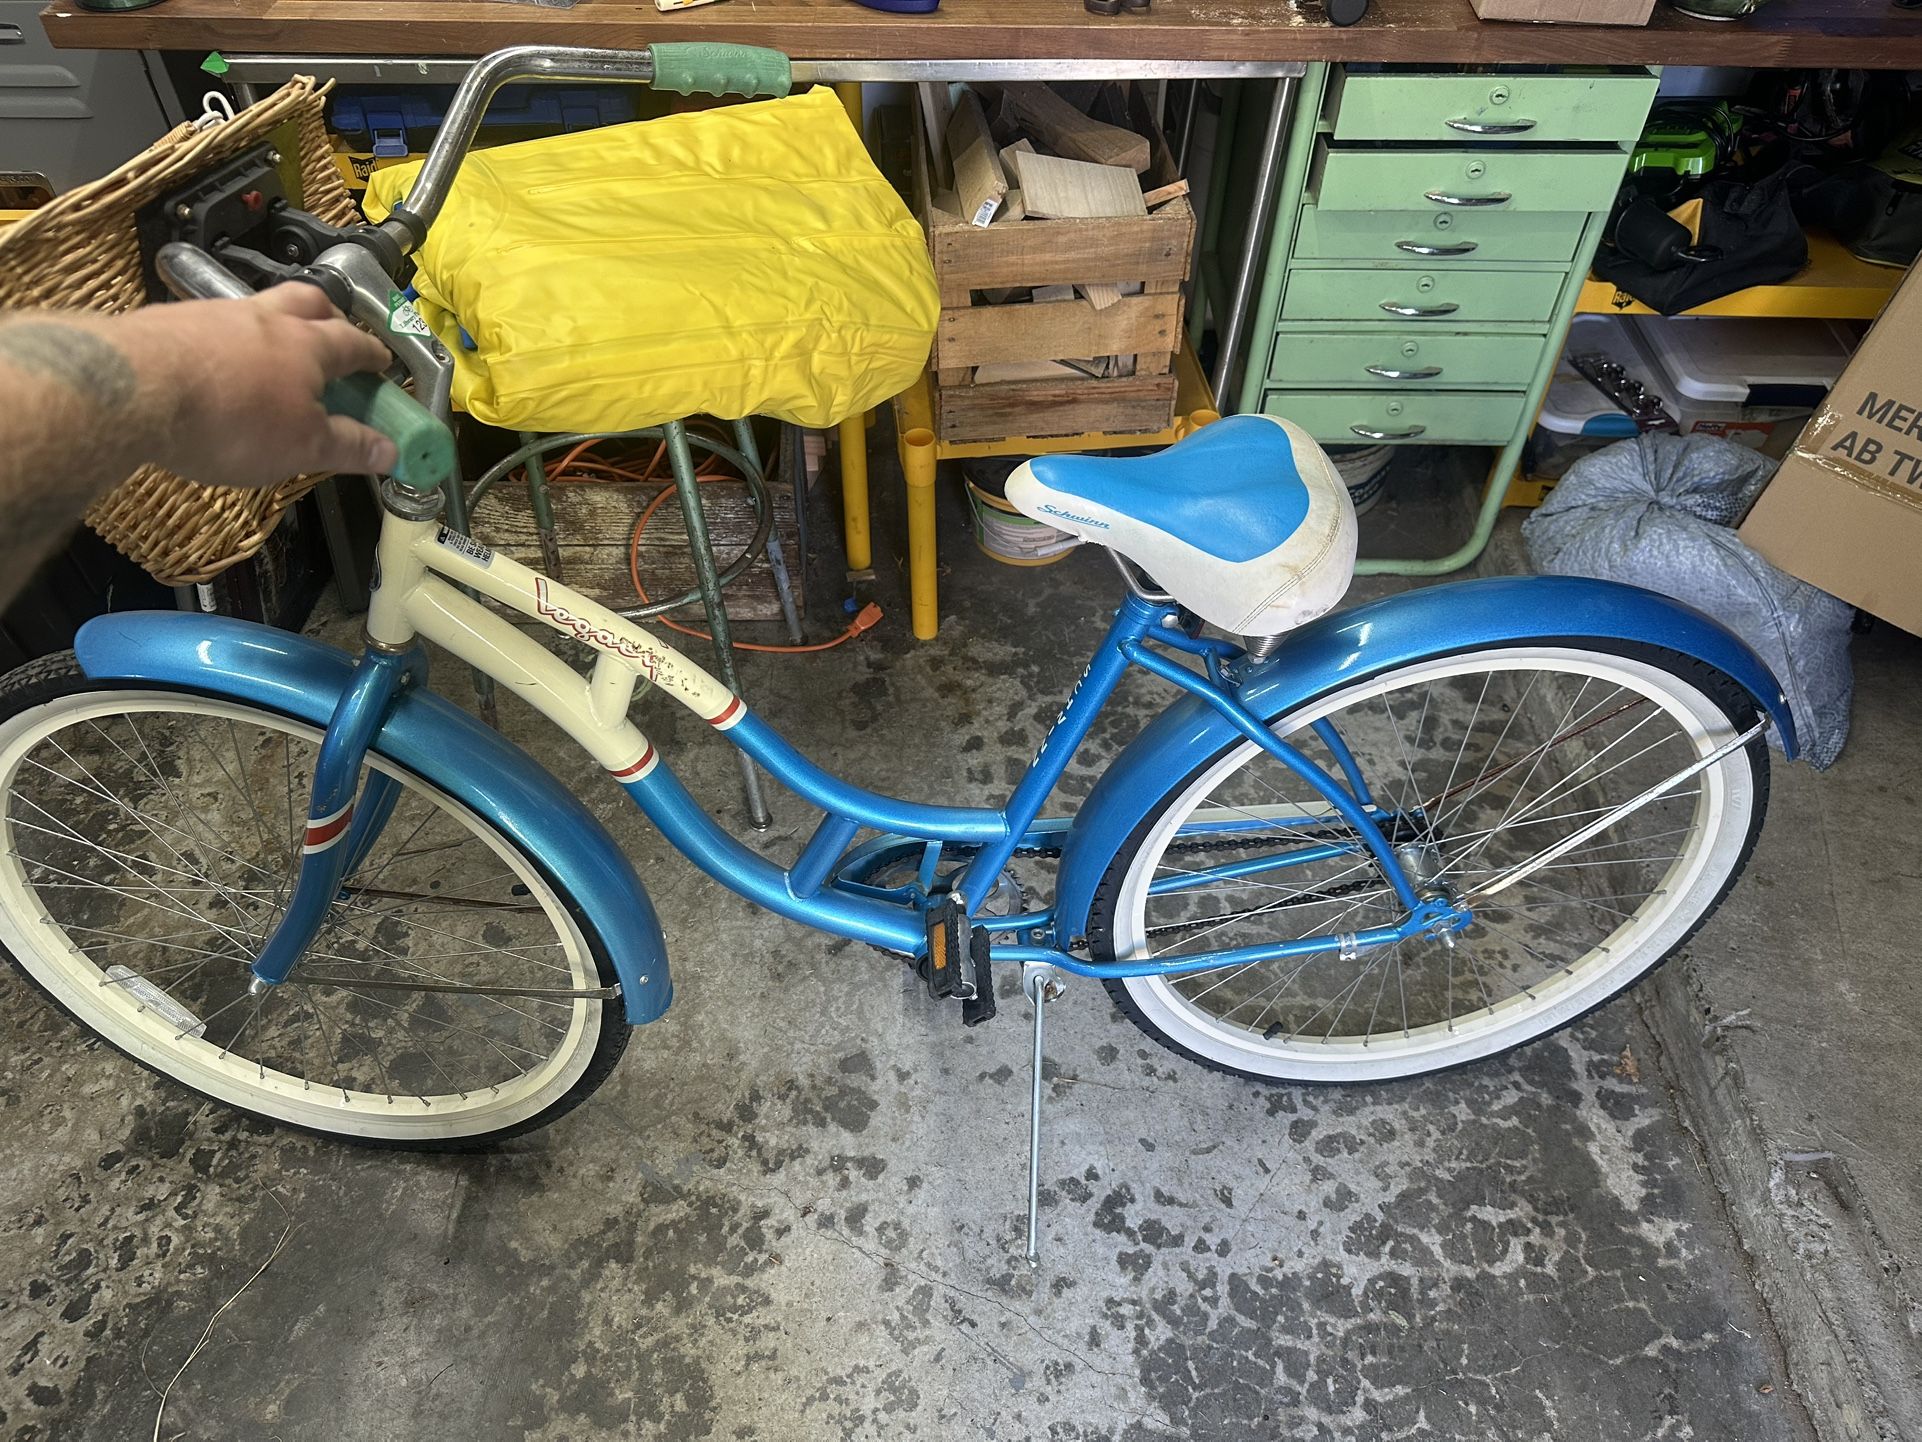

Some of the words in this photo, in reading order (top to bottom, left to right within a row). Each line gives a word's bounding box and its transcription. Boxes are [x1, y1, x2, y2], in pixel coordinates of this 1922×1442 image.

[353, 159, 378, 178] Raid
[1830, 430, 1884, 465] AB
[1036, 504, 1111, 530] Schwinn
